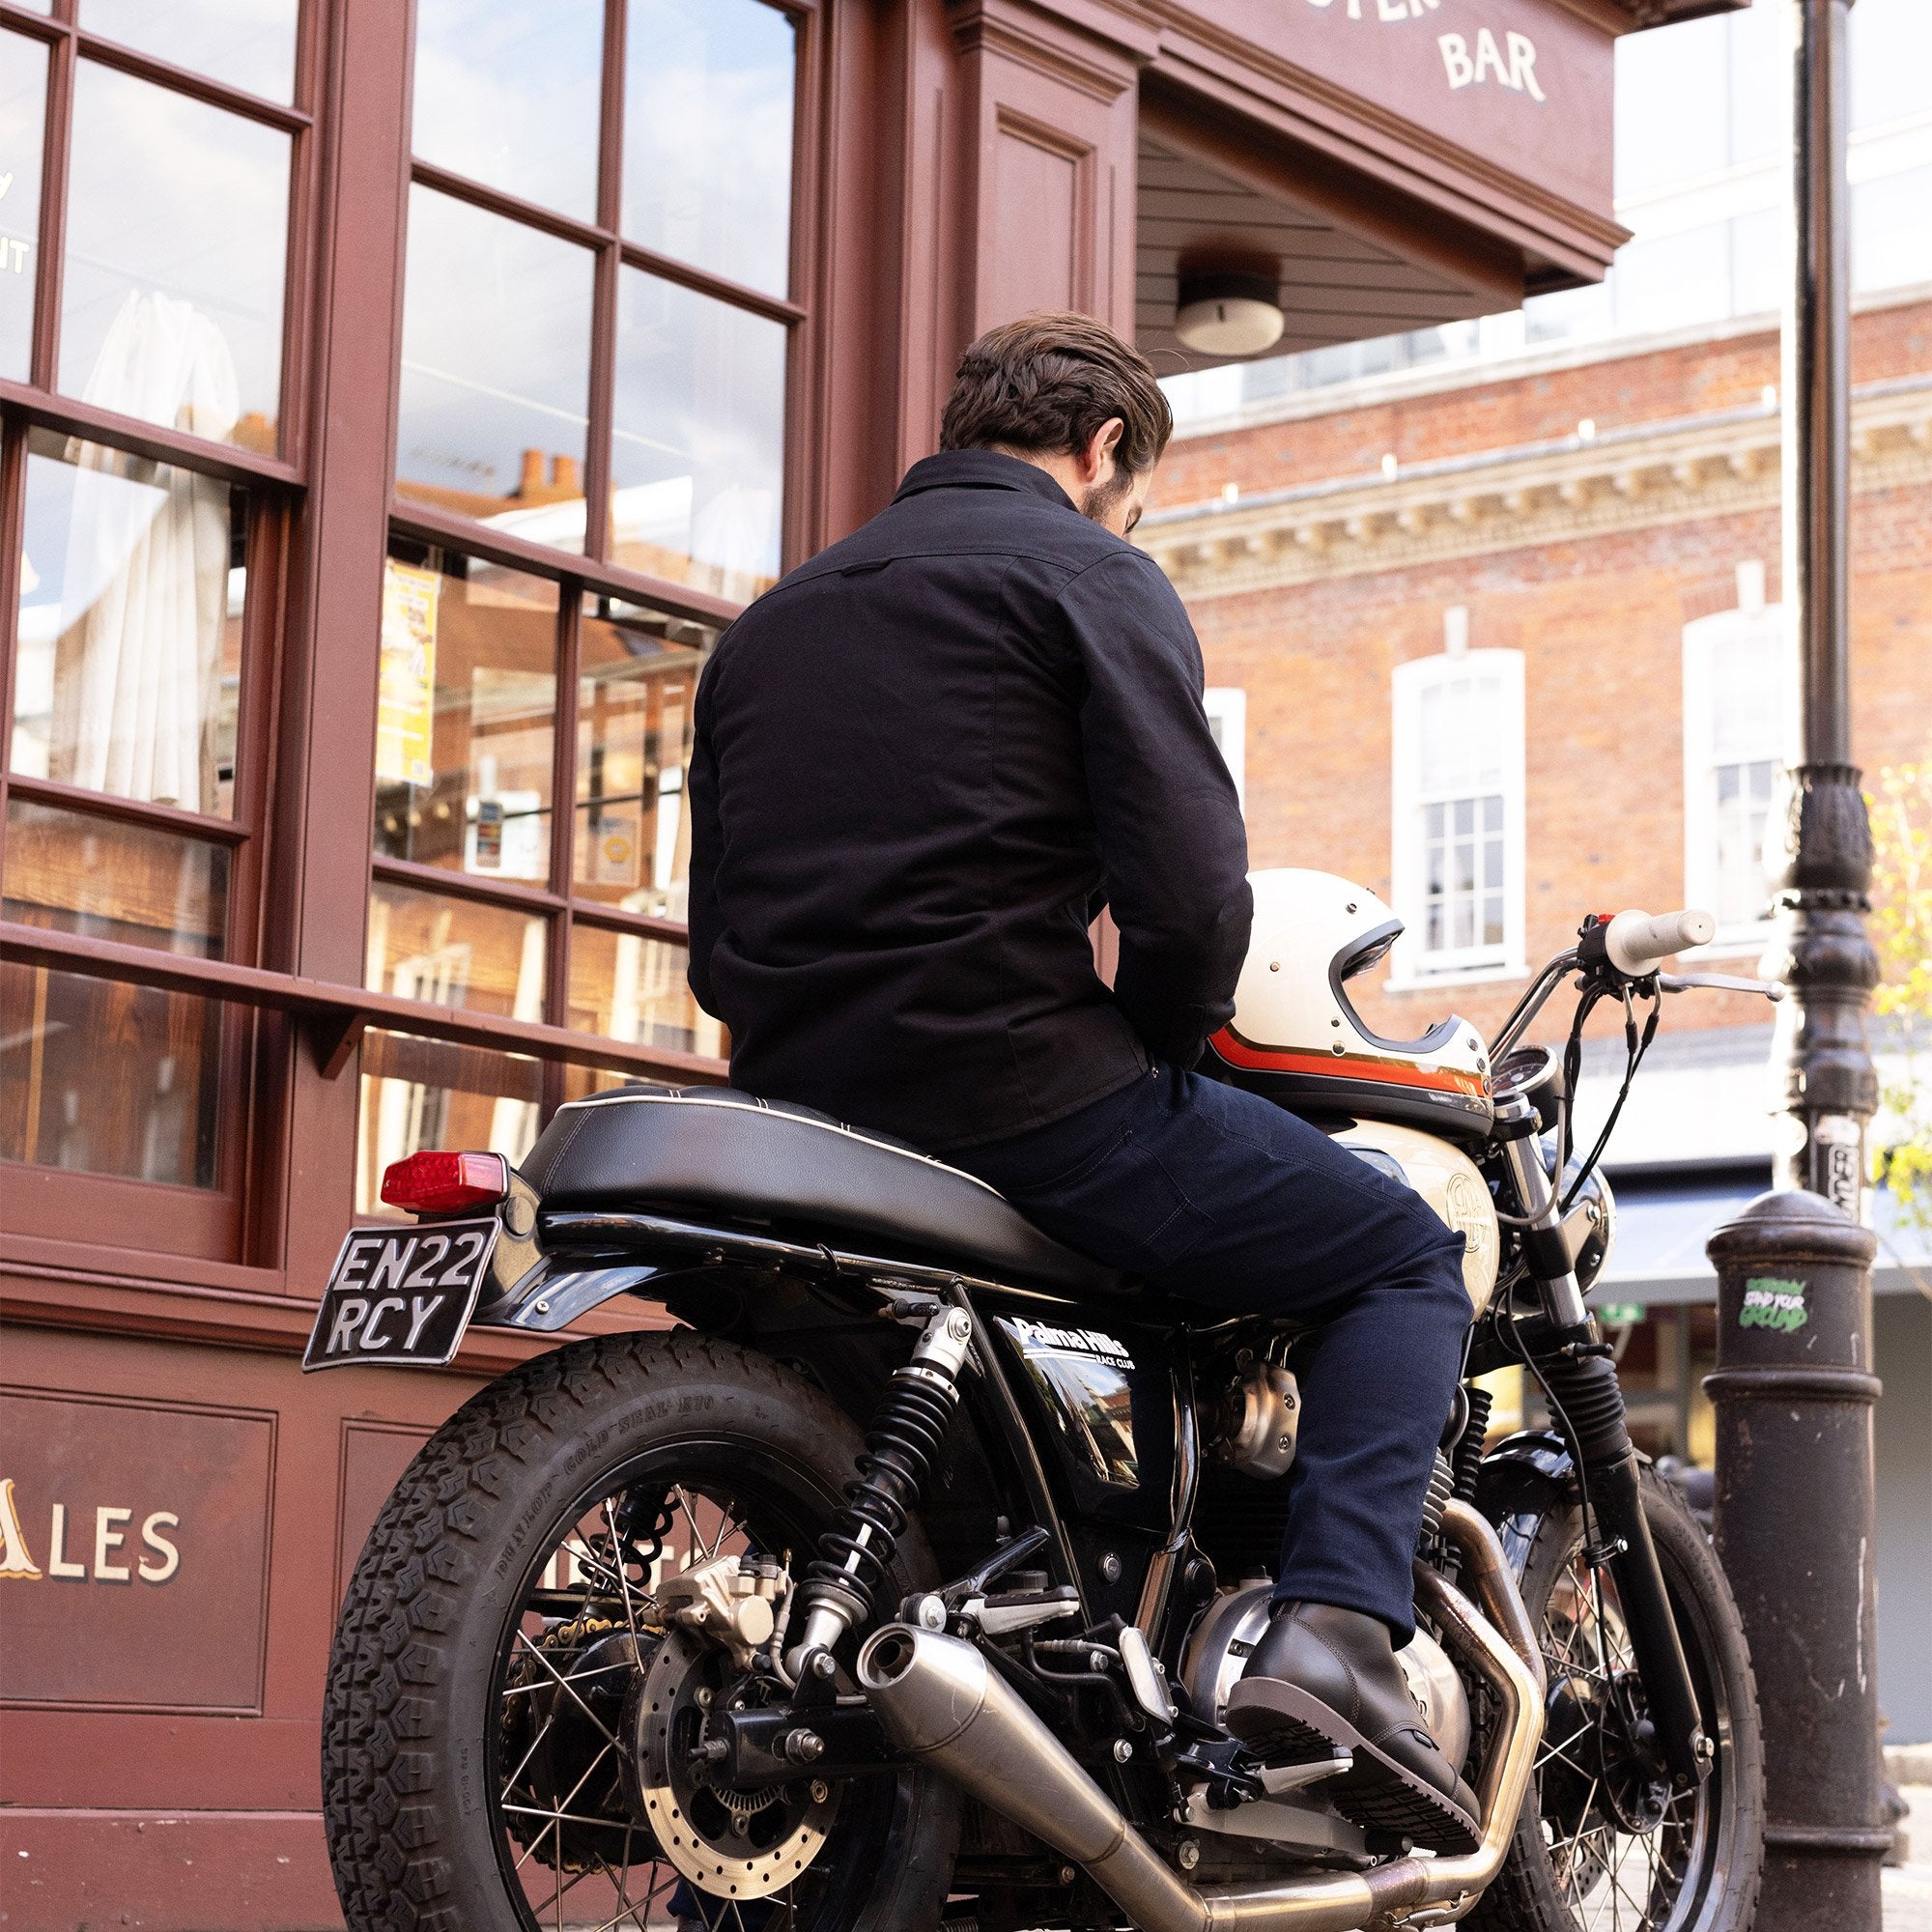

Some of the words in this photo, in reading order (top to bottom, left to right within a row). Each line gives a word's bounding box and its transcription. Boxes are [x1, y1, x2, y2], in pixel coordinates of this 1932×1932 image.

[1437, 27, 1546, 102] BAR
[333, 1232, 485, 1291] EN22
[326, 1294, 446, 1354] RCY
[1094, 1354, 1117, 1367] RACE
[1116, 1357, 1136, 1371] CLUB
